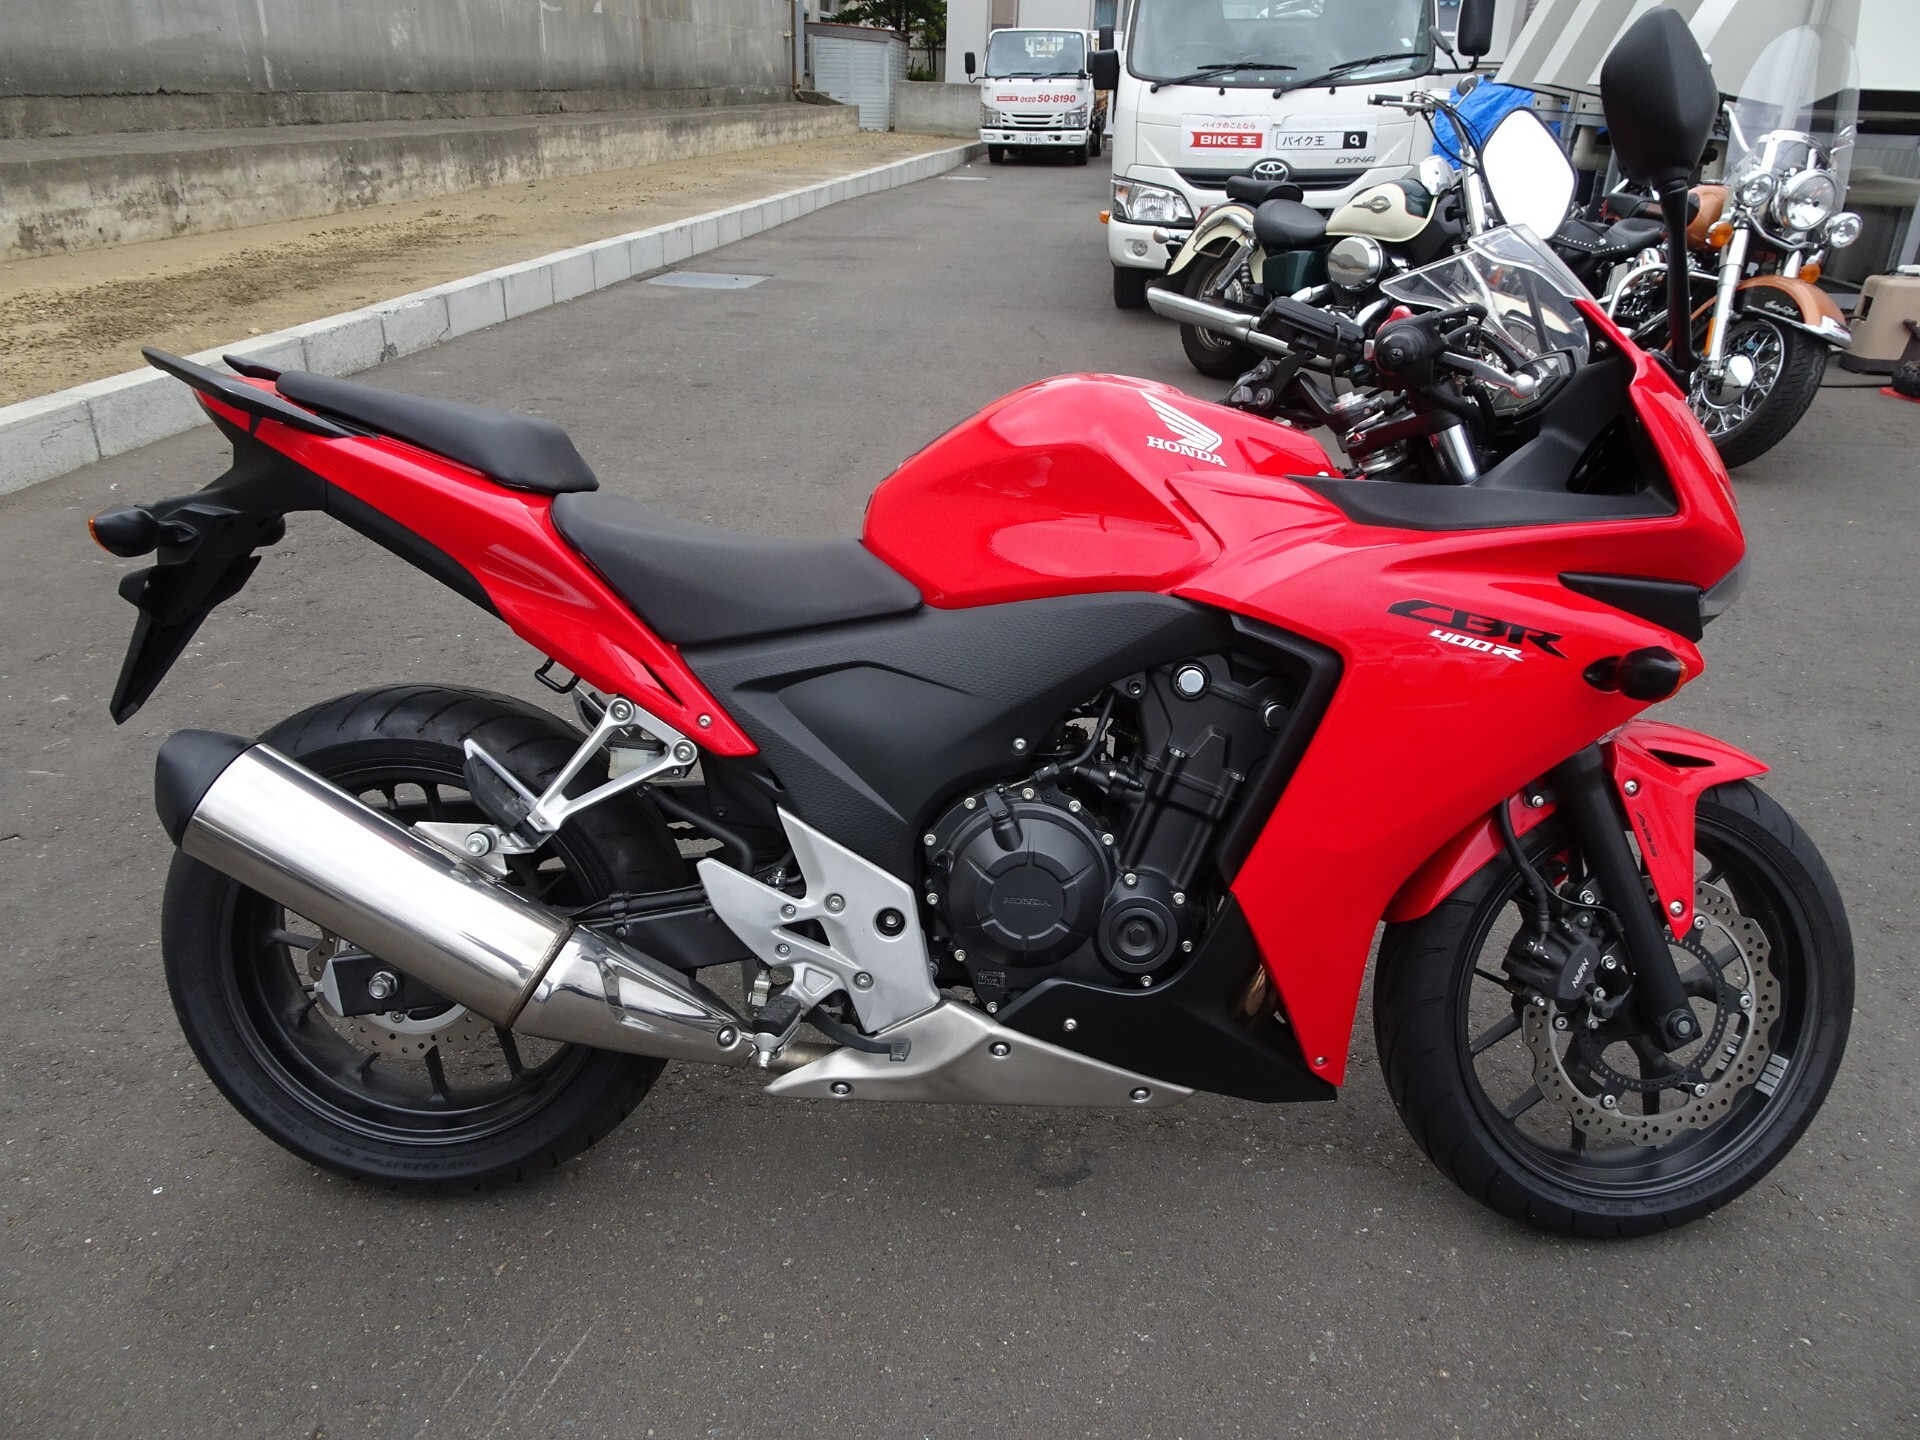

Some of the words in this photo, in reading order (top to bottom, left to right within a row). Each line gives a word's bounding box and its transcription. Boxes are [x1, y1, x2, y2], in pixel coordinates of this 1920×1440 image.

[1202, 122, 1256, 130] バイクのことなら
[1200, 135, 1239, 145] BIKE
[1241, 135, 1257, 146] 王
[1282, 135, 1325, 147] バイク王
[1335, 156, 1376, 165] DYNA
[1146, 435, 1228, 468] HONDA
[1387, 598, 1569, 660] CBR
[1429, 629, 1524, 662] 400R
[1003, 896, 1052, 907] HONDA
